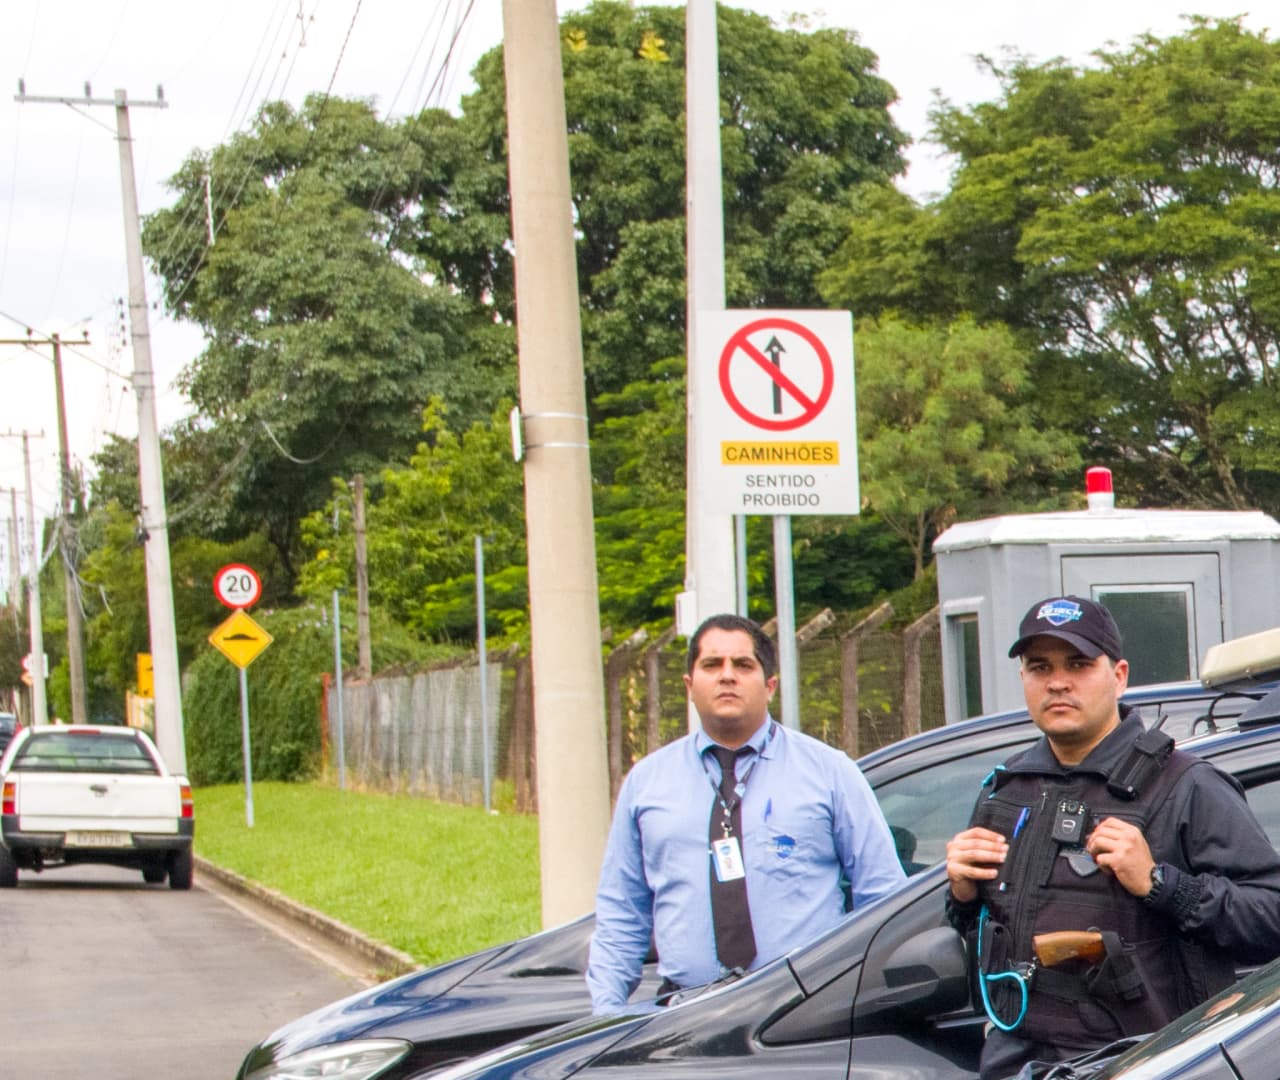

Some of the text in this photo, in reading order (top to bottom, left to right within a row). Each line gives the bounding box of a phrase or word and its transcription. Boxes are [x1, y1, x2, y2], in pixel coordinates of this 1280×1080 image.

[725, 443, 834, 462] CAMINHÕES
[745, 474, 816, 488] SENTIDO
[742, 493, 821, 507] PROIBIDO
[225, 574, 252, 594] 20
